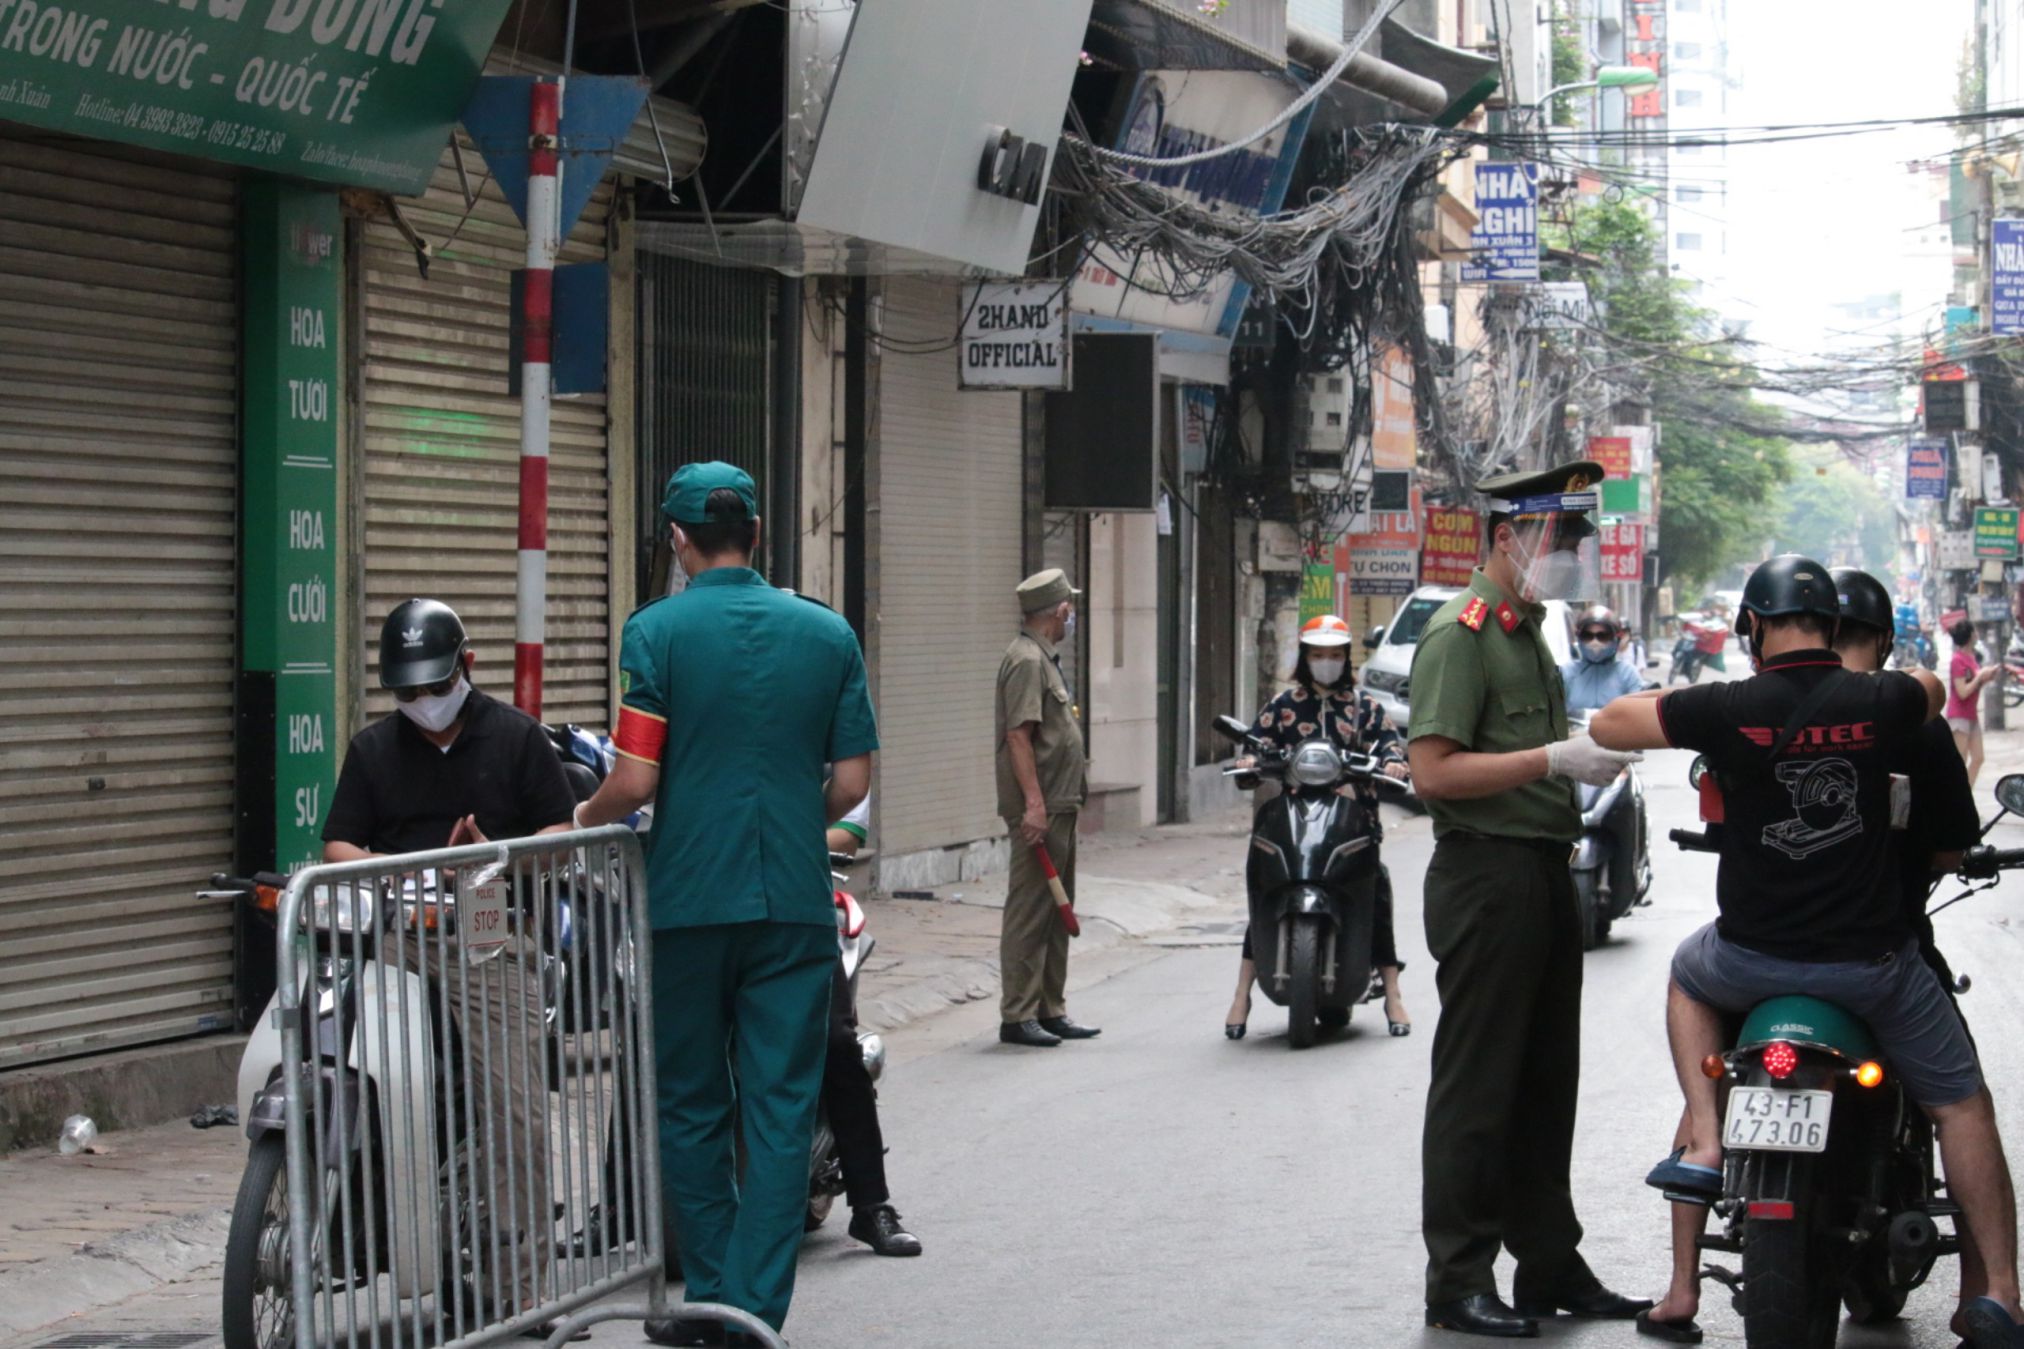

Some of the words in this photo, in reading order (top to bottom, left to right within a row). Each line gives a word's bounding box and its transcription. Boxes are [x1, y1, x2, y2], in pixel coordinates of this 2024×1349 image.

[107, 26, 208, 90] NƯỚC
[235, 53, 328, 116] QUỐC
[326, 67, 379, 125] TẾ
[75, 94, 124, 124] Hotline:
[123, 102, 144, 128] 04
[141, 105, 175, 134] 3993
[1474, 166, 1531, 199] NHÀ
[291, 306, 326, 349] HOA
[978, 305, 1049, 330] 2HAND
[968, 343, 1057, 368] OFFICIAL
[289, 377, 327, 421] TƯƠI
[290, 510, 325, 550] HOA
[288, 574, 326, 623] CƯỚI
[289, 714, 325, 754] HOA
[296, 783, 320, 835] SỰ
[476, 887, 496, 900] POLICE
[474, 910, 500, 932] STOP
[1743, 1092, 1813, 1119] 43-F1
[1730, 1118, 1822, 1148] 473.06
